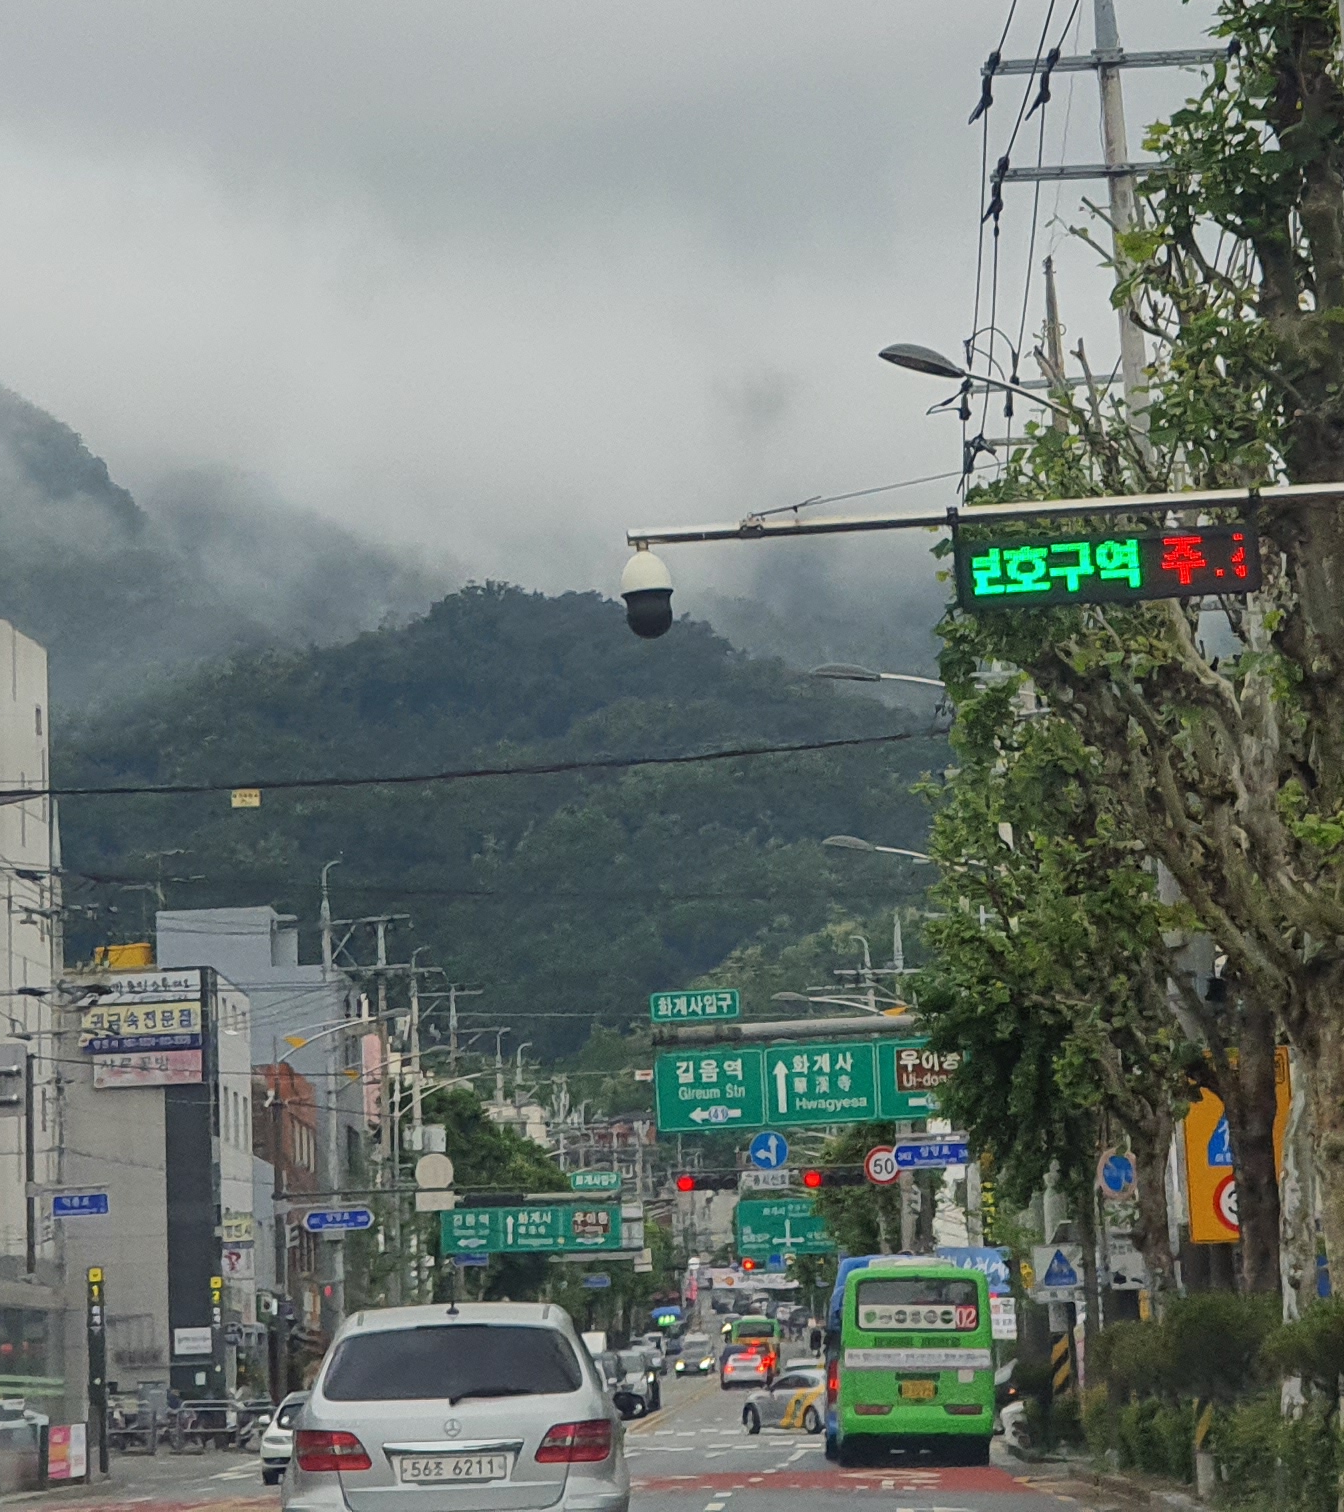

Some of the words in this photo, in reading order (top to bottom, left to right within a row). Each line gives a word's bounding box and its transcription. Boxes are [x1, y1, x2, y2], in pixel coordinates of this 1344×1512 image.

[658, 993, 732, 1017] 화계사입구
[676, 1058, 745, 1085] 길음역
[792, 1051, 854, 1074] 화계사
[678, 1085, 721, 1101] Gireum
[725, 1082, 746, 1098] Stn
[795, 1095, 868, 1112] Hwagyesa
[873, 1158, 895, 1176] 50
[452, 1458, 495, 1476] 6211
